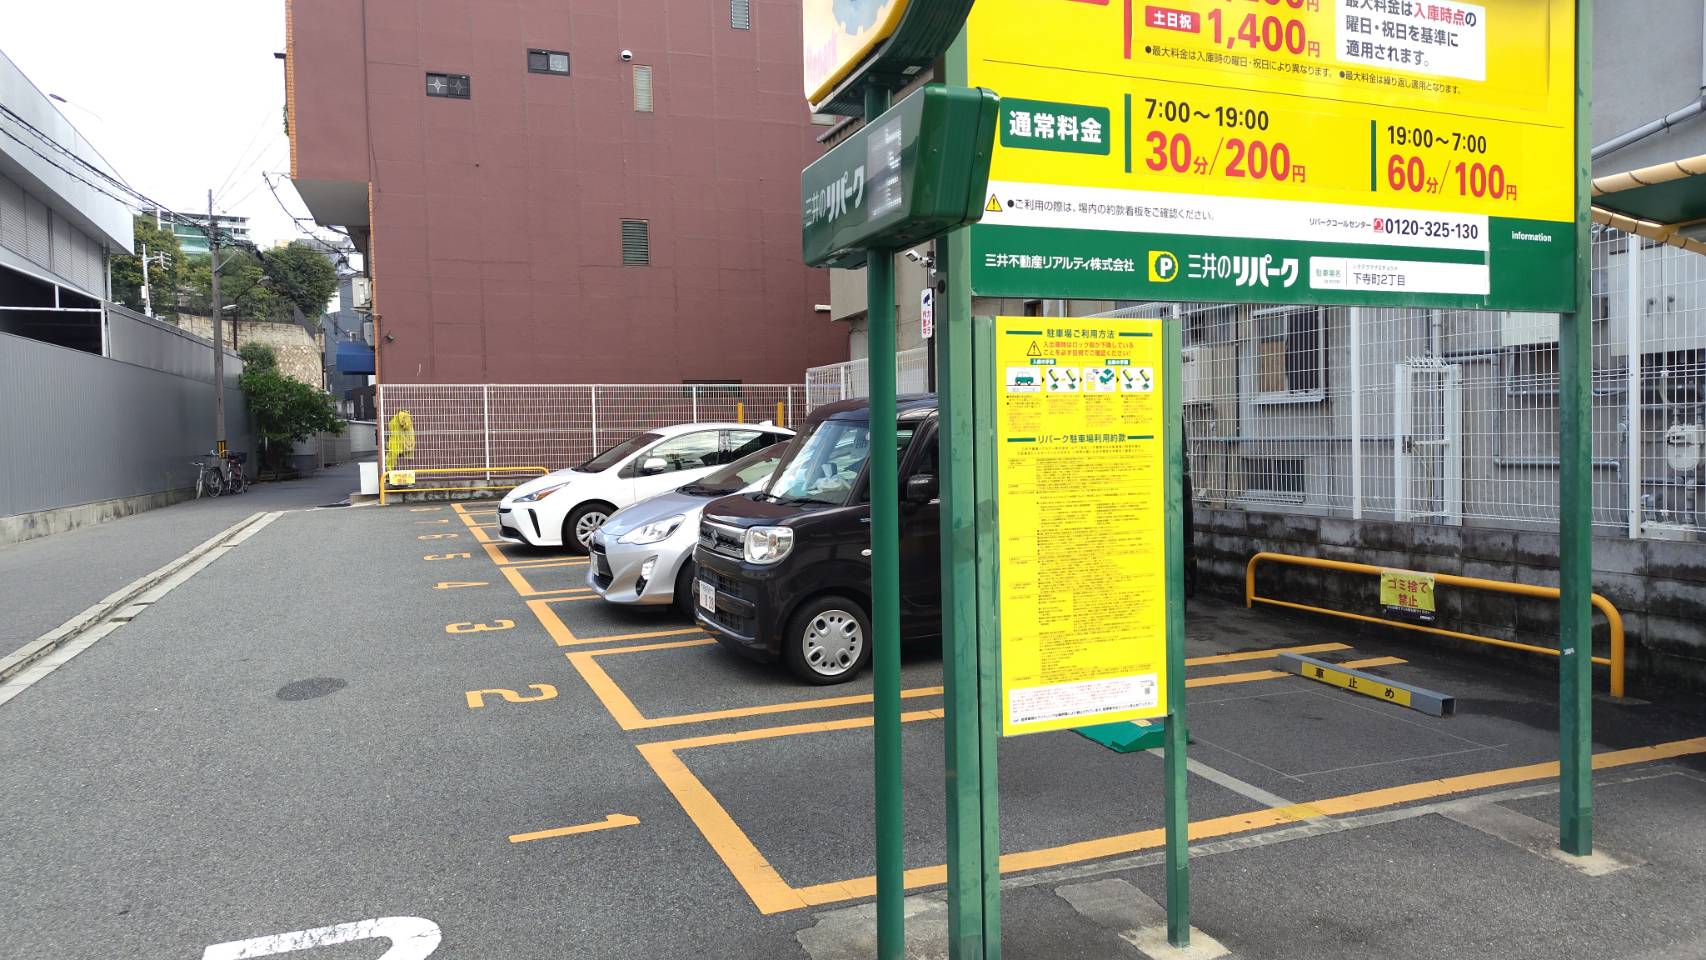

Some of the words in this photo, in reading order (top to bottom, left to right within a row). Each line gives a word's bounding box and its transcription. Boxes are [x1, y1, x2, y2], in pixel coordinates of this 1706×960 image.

[1153, 11, 1192, 30] 土日祝
[1207, 8, 1321, 58] 1,400円
[1346, 15, 1459, 48] 曜日・祝日を基準に
[1346, 39, 1430, 67] 適用されます。
[1008, 110, 1103, 144] 通常料金
[805, 165, 865, 227] 三井のリパーク
[1385, 218, 1479, 240] 0120-325-130
[984, 253, 1136, 273] 三井不動産リアルティ株式会社
[1187, 252, 1299, 288] 三井のリパーク
[1352, 272, 1406, 287] 下寺町2丁目
[1046, 328, 1115, 339] 駐車場ご利用方法
[423, 552, 472, 561] 5
[433, 581, 490, 589] 4
[1387, 578, 1428, 594] ゴミ捨て
[1398, 594, 1419, 608] 禁止
[445, 618, 516, 635] 3
[465, 683, 559, 709] 2
[1315, 667, 1395, 699] 車止め
[507, 813, 641, 844] 1
